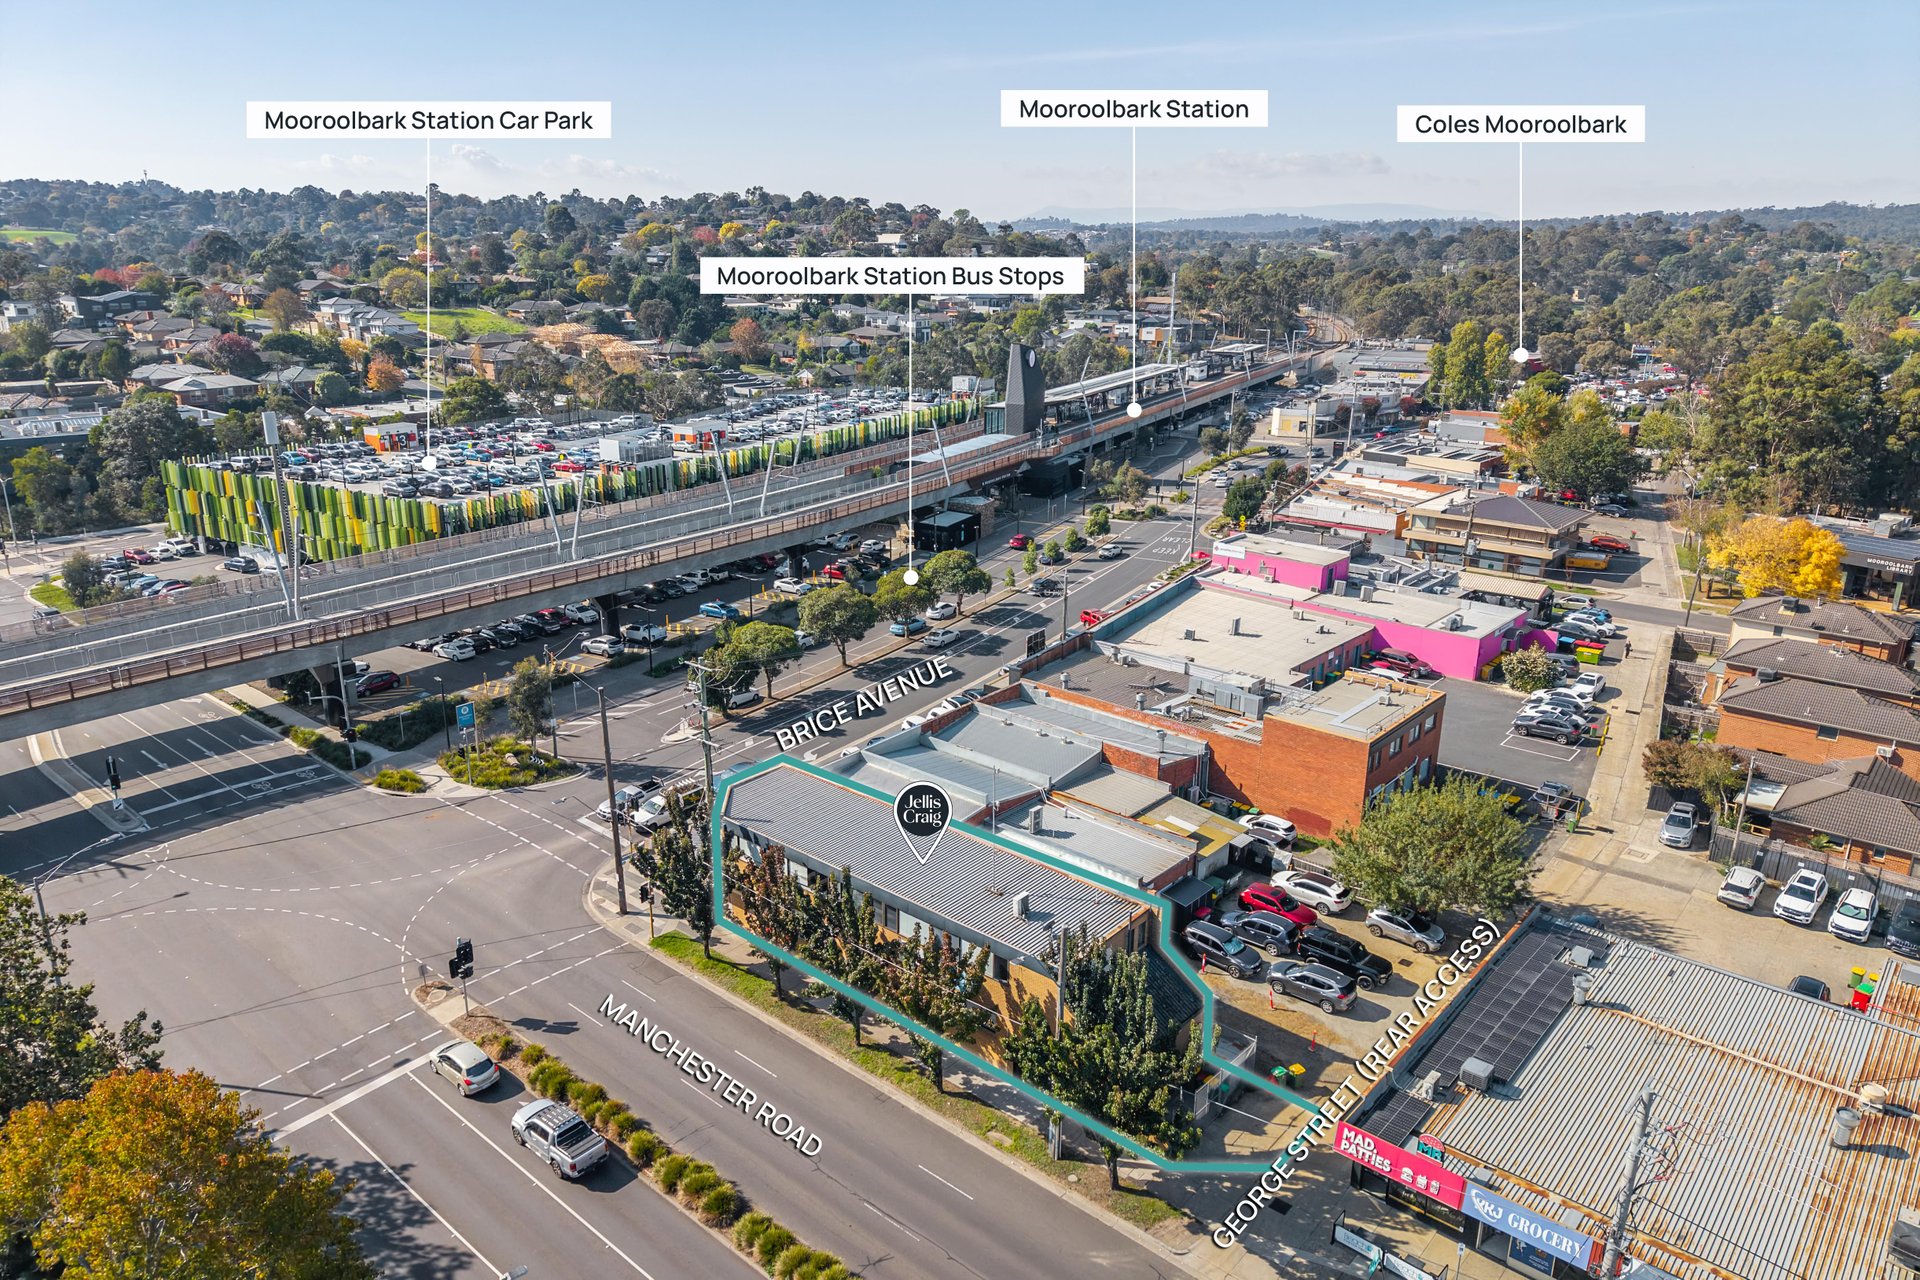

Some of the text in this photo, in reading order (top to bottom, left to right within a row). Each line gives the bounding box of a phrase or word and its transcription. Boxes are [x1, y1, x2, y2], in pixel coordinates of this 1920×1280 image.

[399, 434, 407, 446] 3
[1152, 544, 1180, 555] KEEP
[1866, 557, 1914, 570] MOOROOLBARK
[1340, 1139, 1392, 1172] PATTIES
[1507, 1213, 1585, 1259] GROCERY
